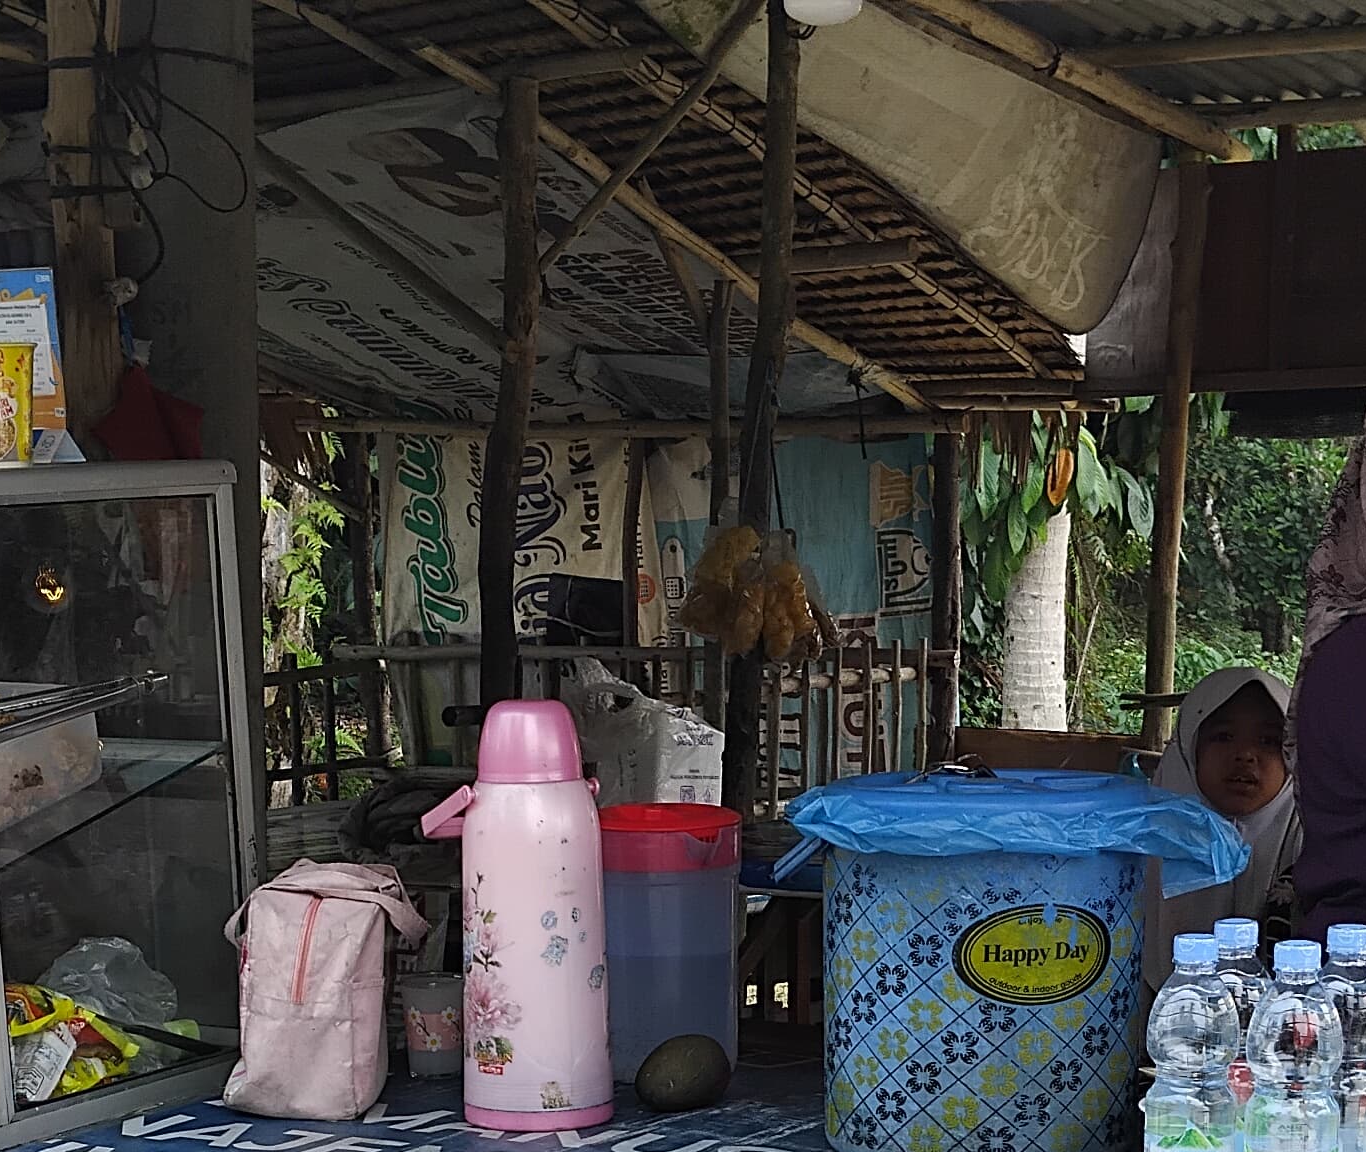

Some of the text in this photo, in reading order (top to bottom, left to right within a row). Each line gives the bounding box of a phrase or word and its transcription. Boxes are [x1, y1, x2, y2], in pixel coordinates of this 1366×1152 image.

[573, 480, 603, 553] Mari
[982, 942, 1090, 967] Happy Day
